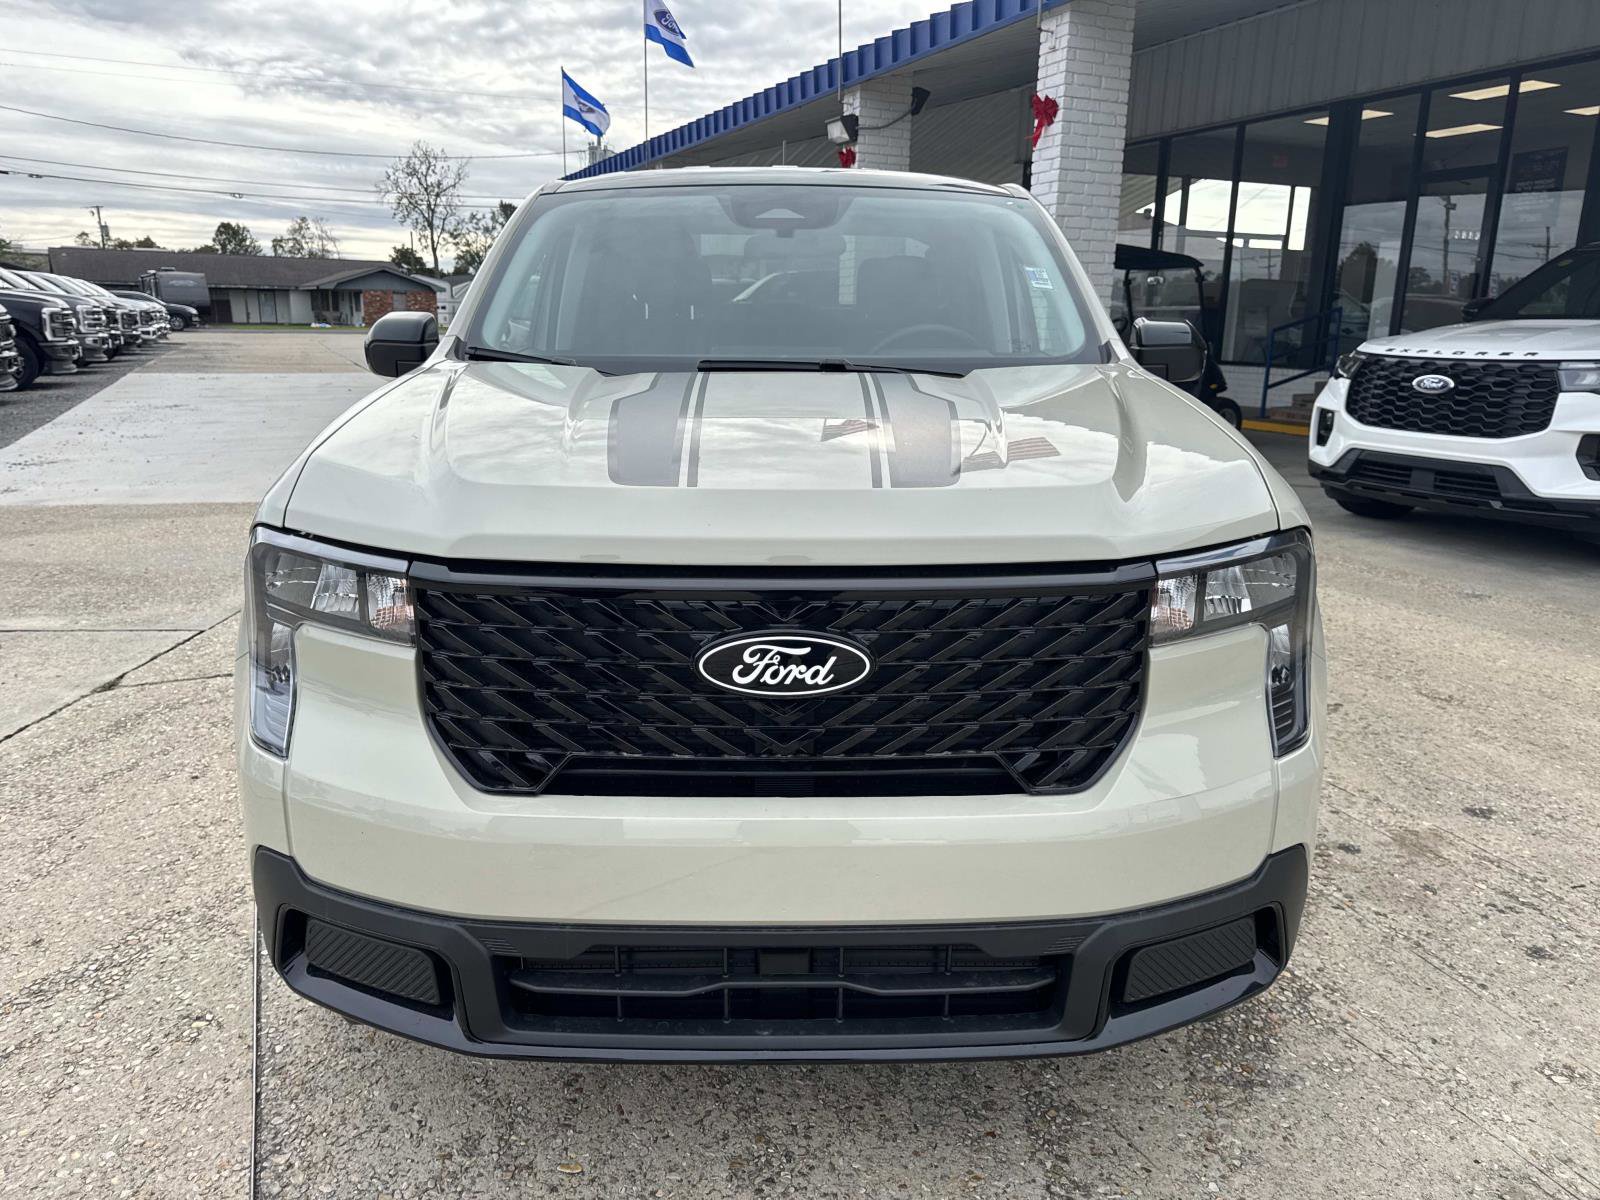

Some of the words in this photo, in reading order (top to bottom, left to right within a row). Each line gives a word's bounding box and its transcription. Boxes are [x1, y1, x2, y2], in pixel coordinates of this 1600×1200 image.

[1385, 347, 1539, 357] EXPLORER
[1420, 377, 1444, 389] Ford
[732, 644, 837, 685] Ford
